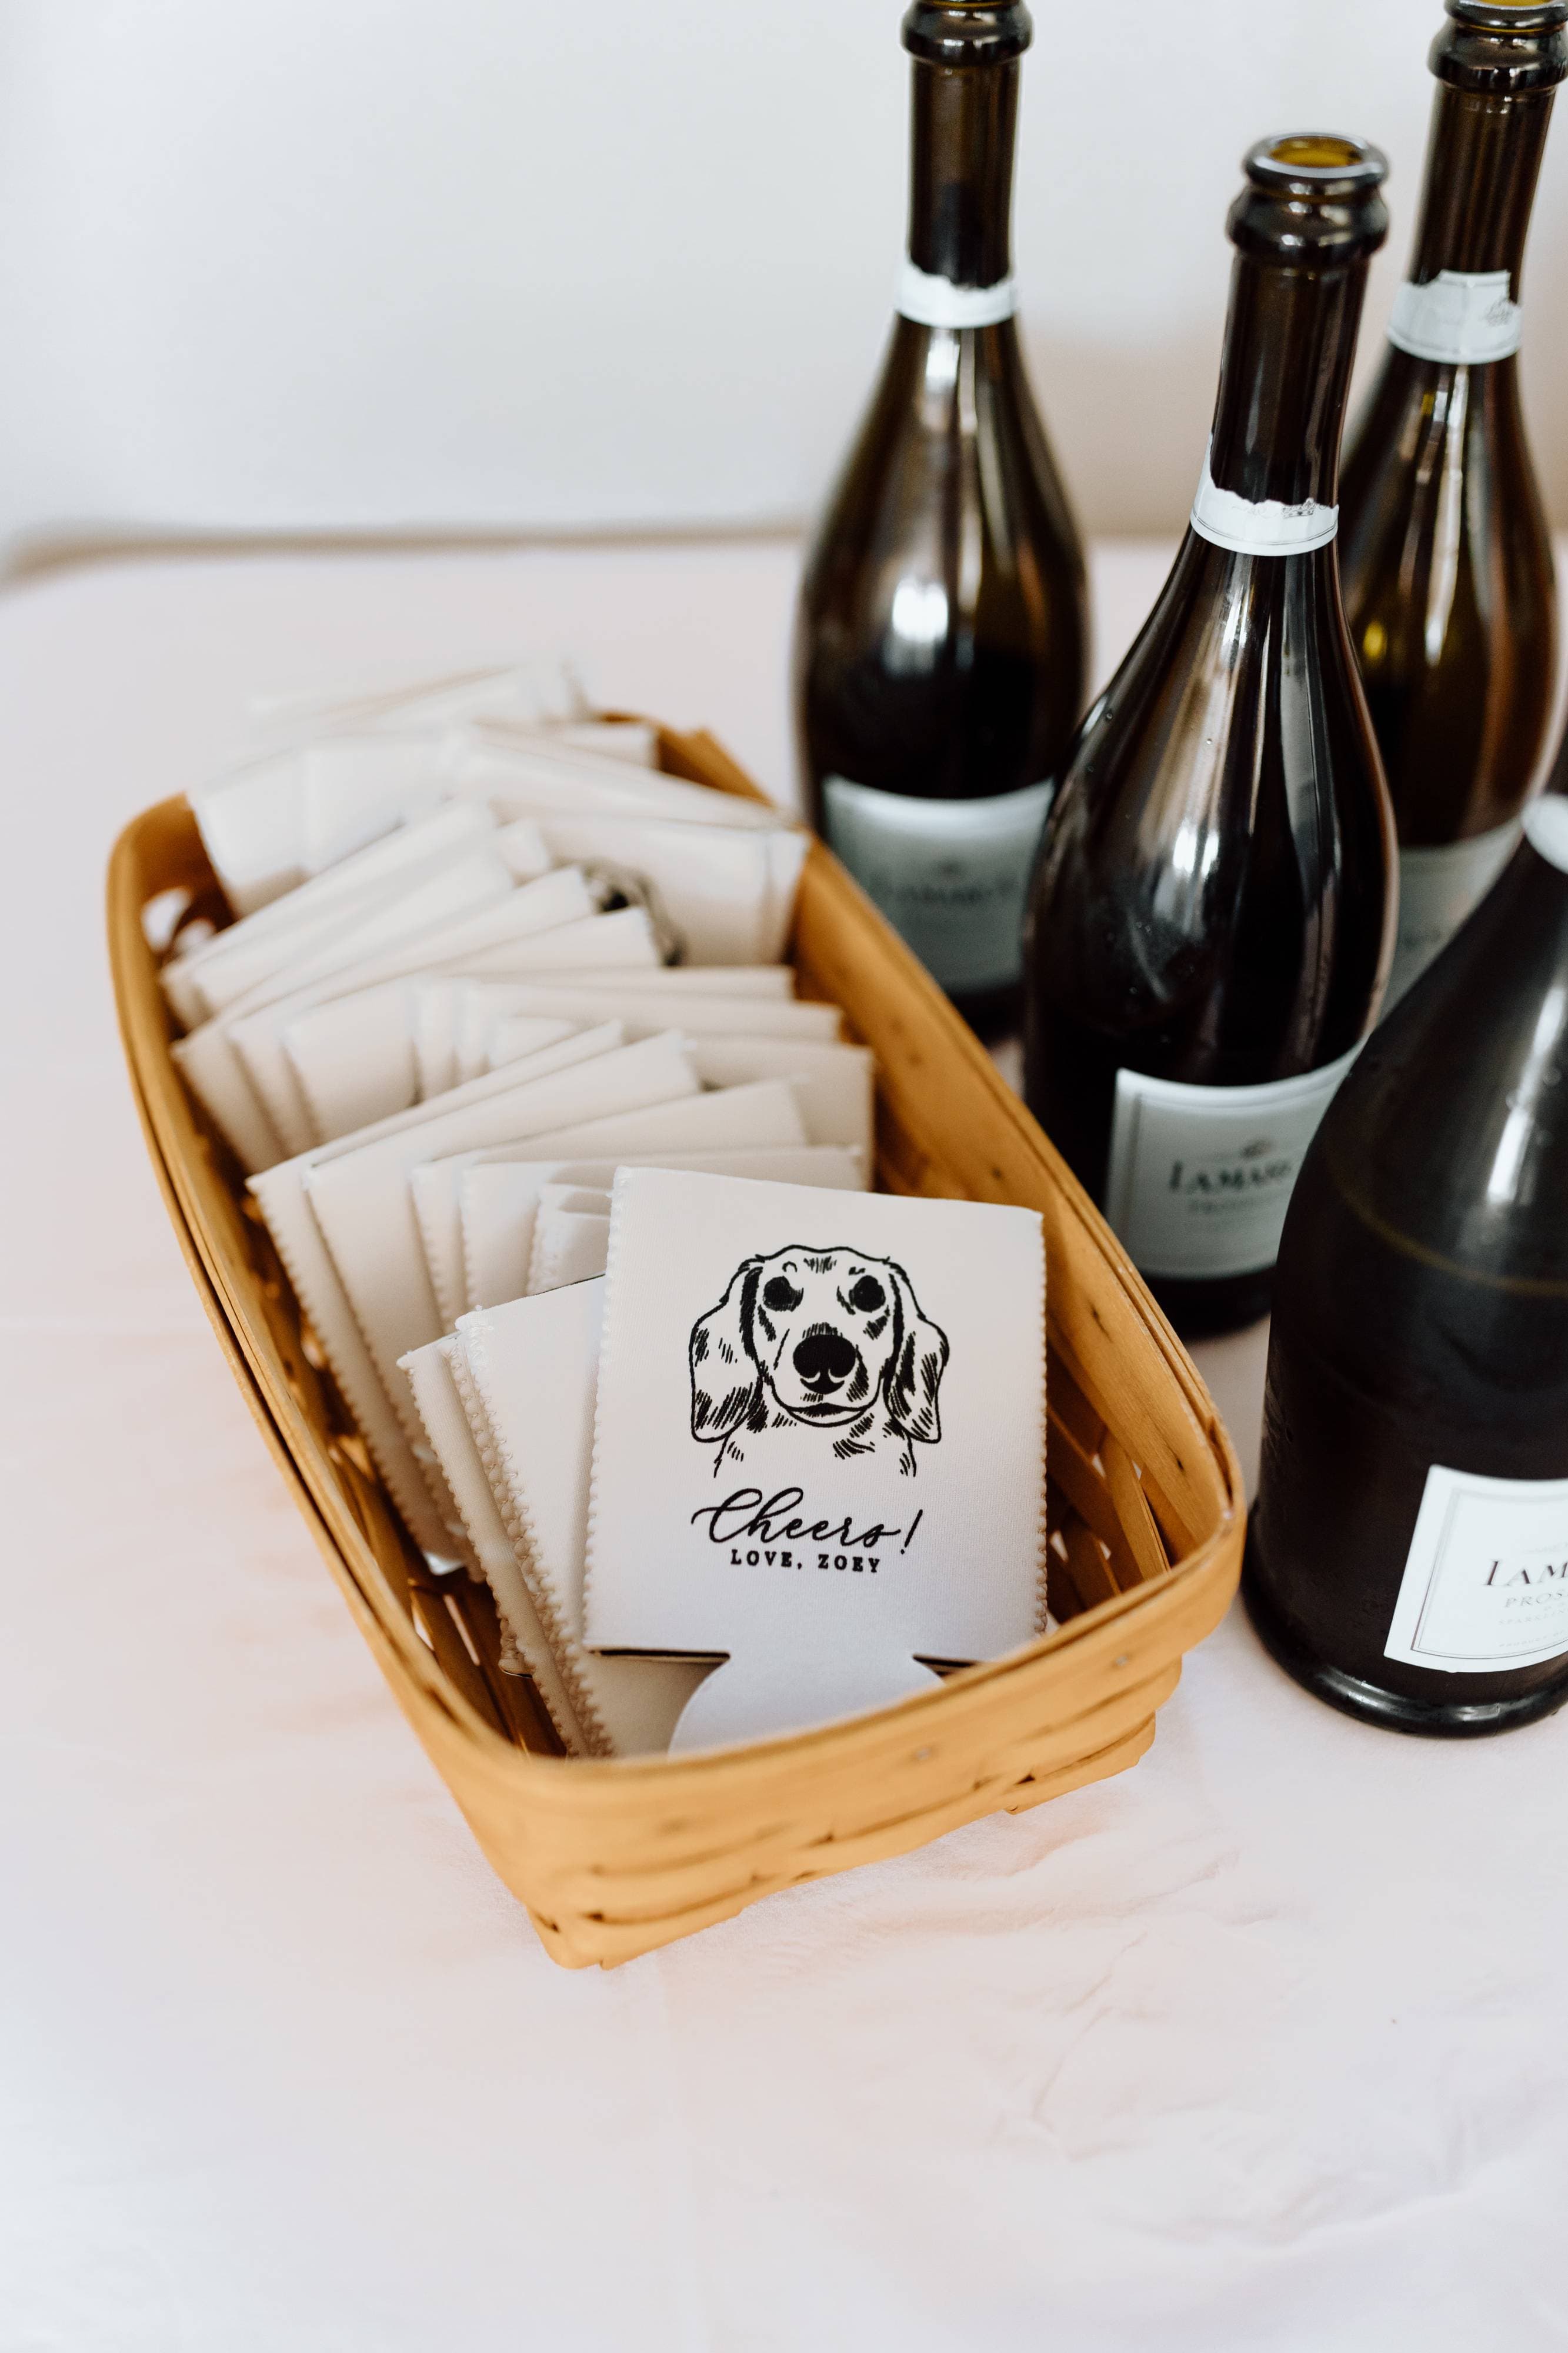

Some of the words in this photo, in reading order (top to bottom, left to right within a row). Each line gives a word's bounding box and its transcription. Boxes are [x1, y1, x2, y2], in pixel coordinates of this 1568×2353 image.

[690, 1487, 923, 1555] Cheers!
[730, 1549, 803, 1569] LOVE,
[818, 1553, 881, 1573] ZOEY
